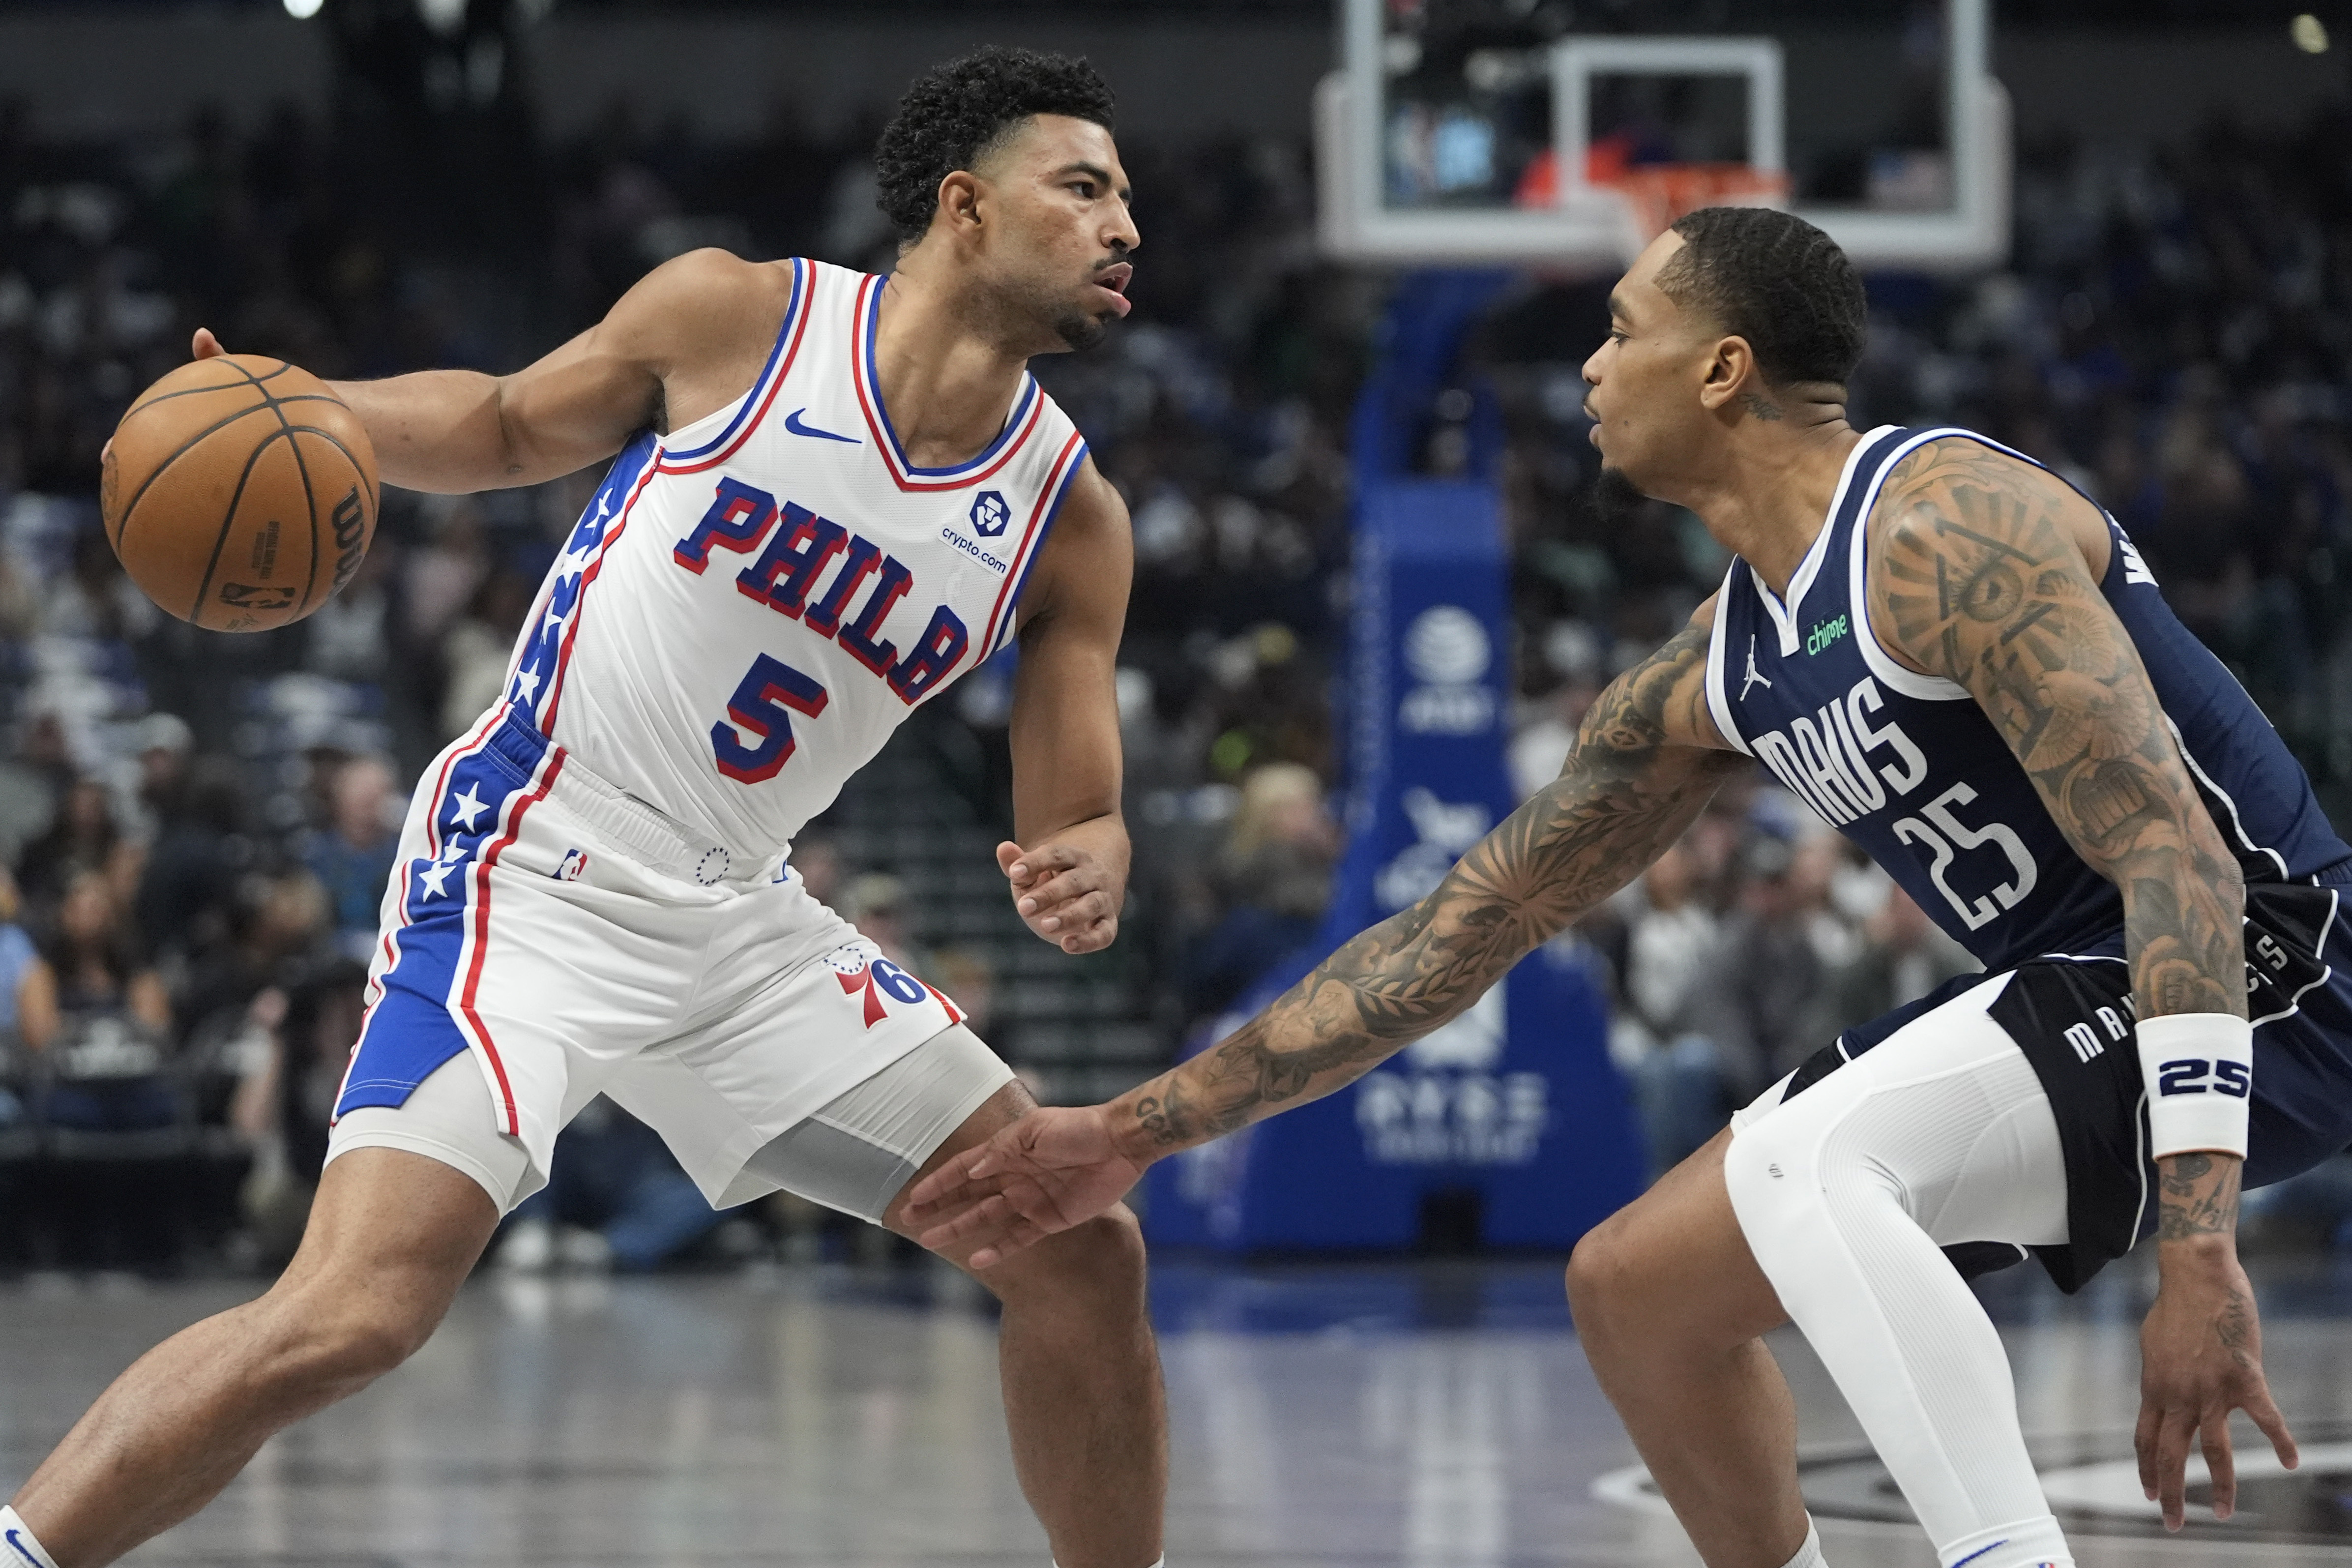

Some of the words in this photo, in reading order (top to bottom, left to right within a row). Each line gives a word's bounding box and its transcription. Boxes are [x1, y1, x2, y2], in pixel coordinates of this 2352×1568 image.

[674, 475, 969, 707] PHILA
[942, 528, 1007, 574] crypto.com
[1807, 614, 1848, 656] chime
[710, 652, 828, 785] 5
[1750, 676, 1928, 828] MAVS
[1893, 781, 2037, 931] 25
[835, 959, 926, 1030] 76
[2159, 1059, 2250, 1098] 25
